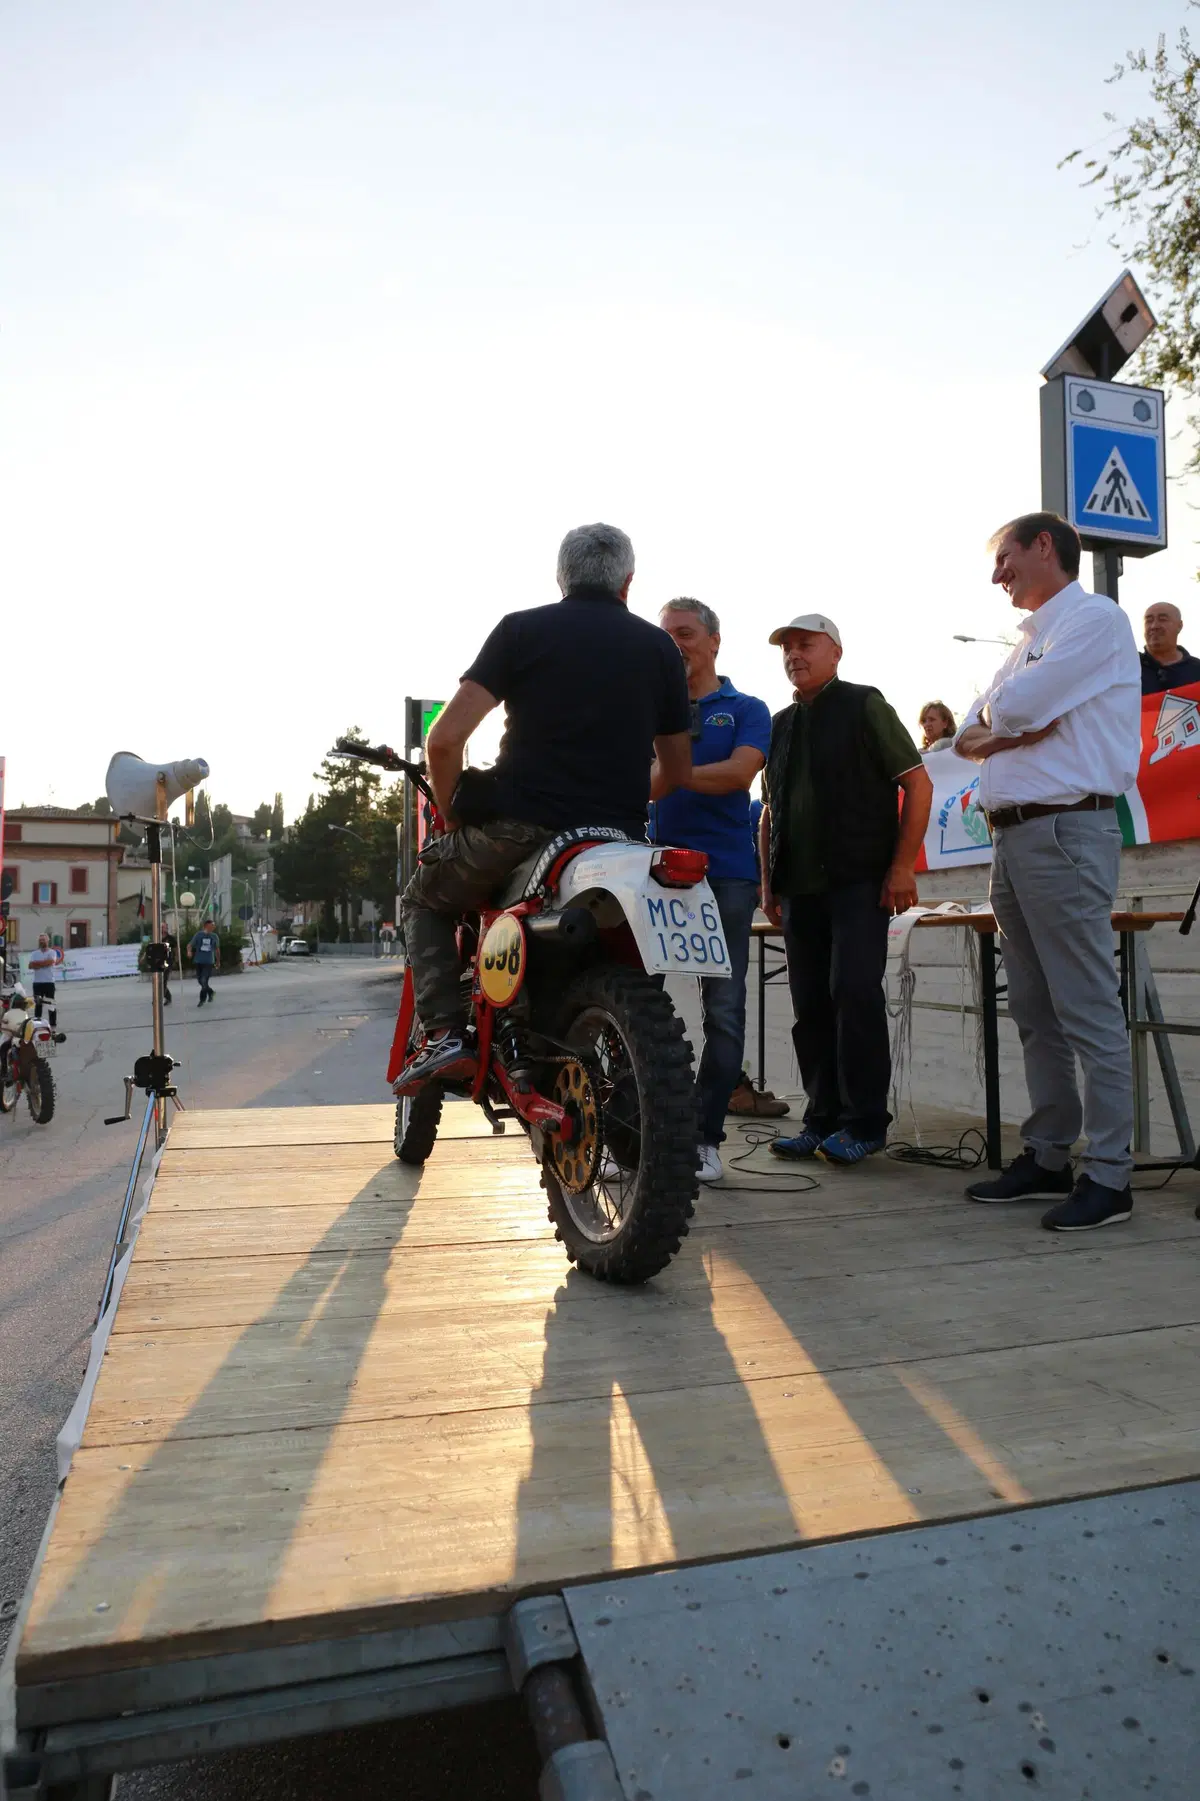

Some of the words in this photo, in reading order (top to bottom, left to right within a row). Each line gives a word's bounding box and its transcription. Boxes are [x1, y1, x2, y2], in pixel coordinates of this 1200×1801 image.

[646, 898, 687, 928] MC
[701, 903, 718, 932] 6
[658, 933, 726, 965] 1390
